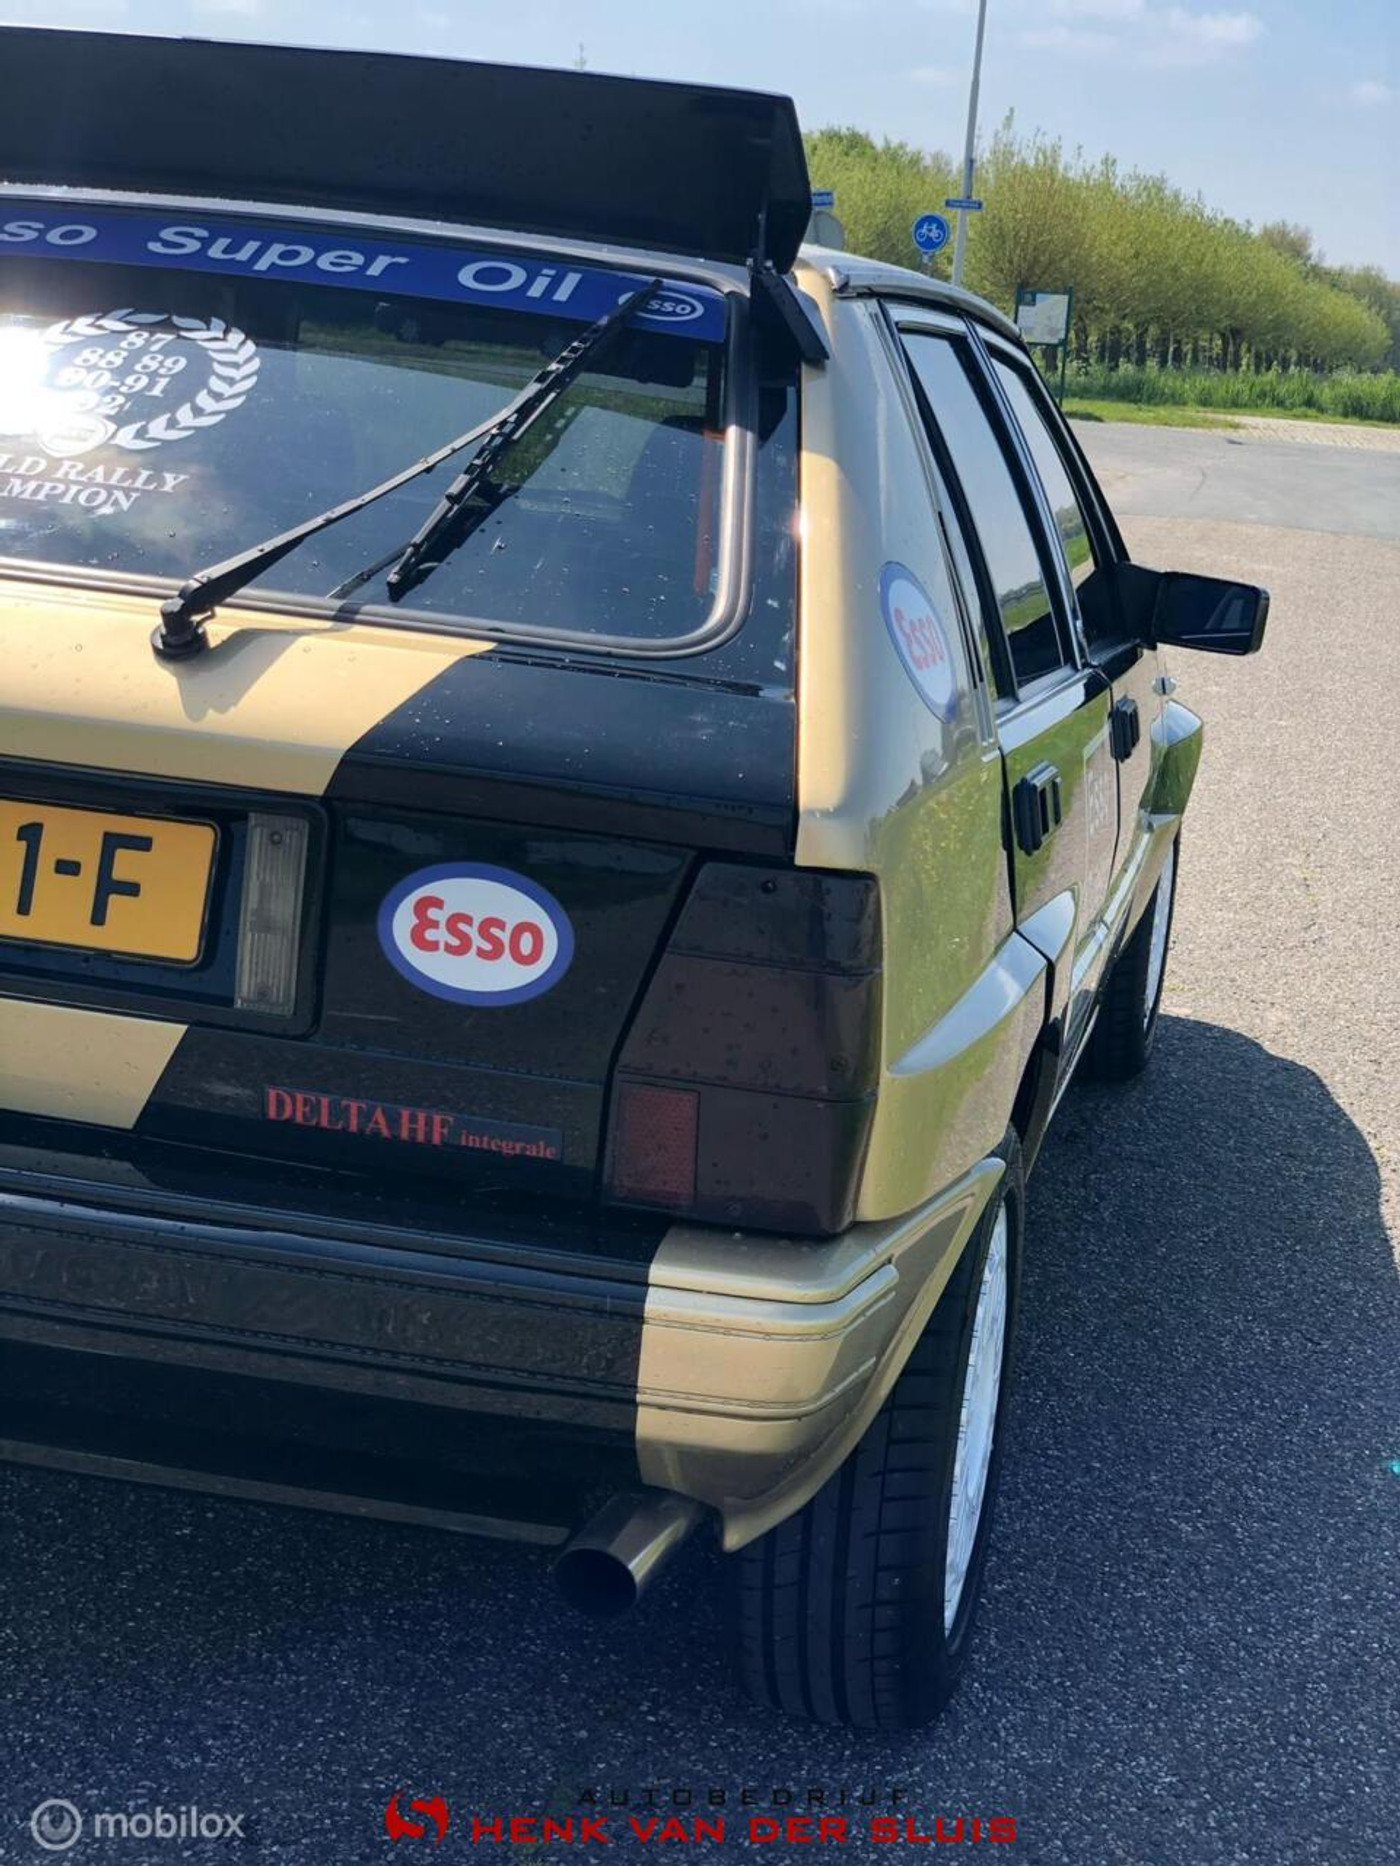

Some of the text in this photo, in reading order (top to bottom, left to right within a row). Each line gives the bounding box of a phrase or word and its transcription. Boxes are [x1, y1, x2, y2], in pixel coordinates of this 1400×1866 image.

[146, 226, 410, 277] Super
[457, 261, 583, 301] Oil
[119, 331, 178, 351] 87
[74, 347, 187, 375] 88 89
[52, 460, 190, 492] RALLY
[266, 1086, 556, 1159] DELTA HF integrale
